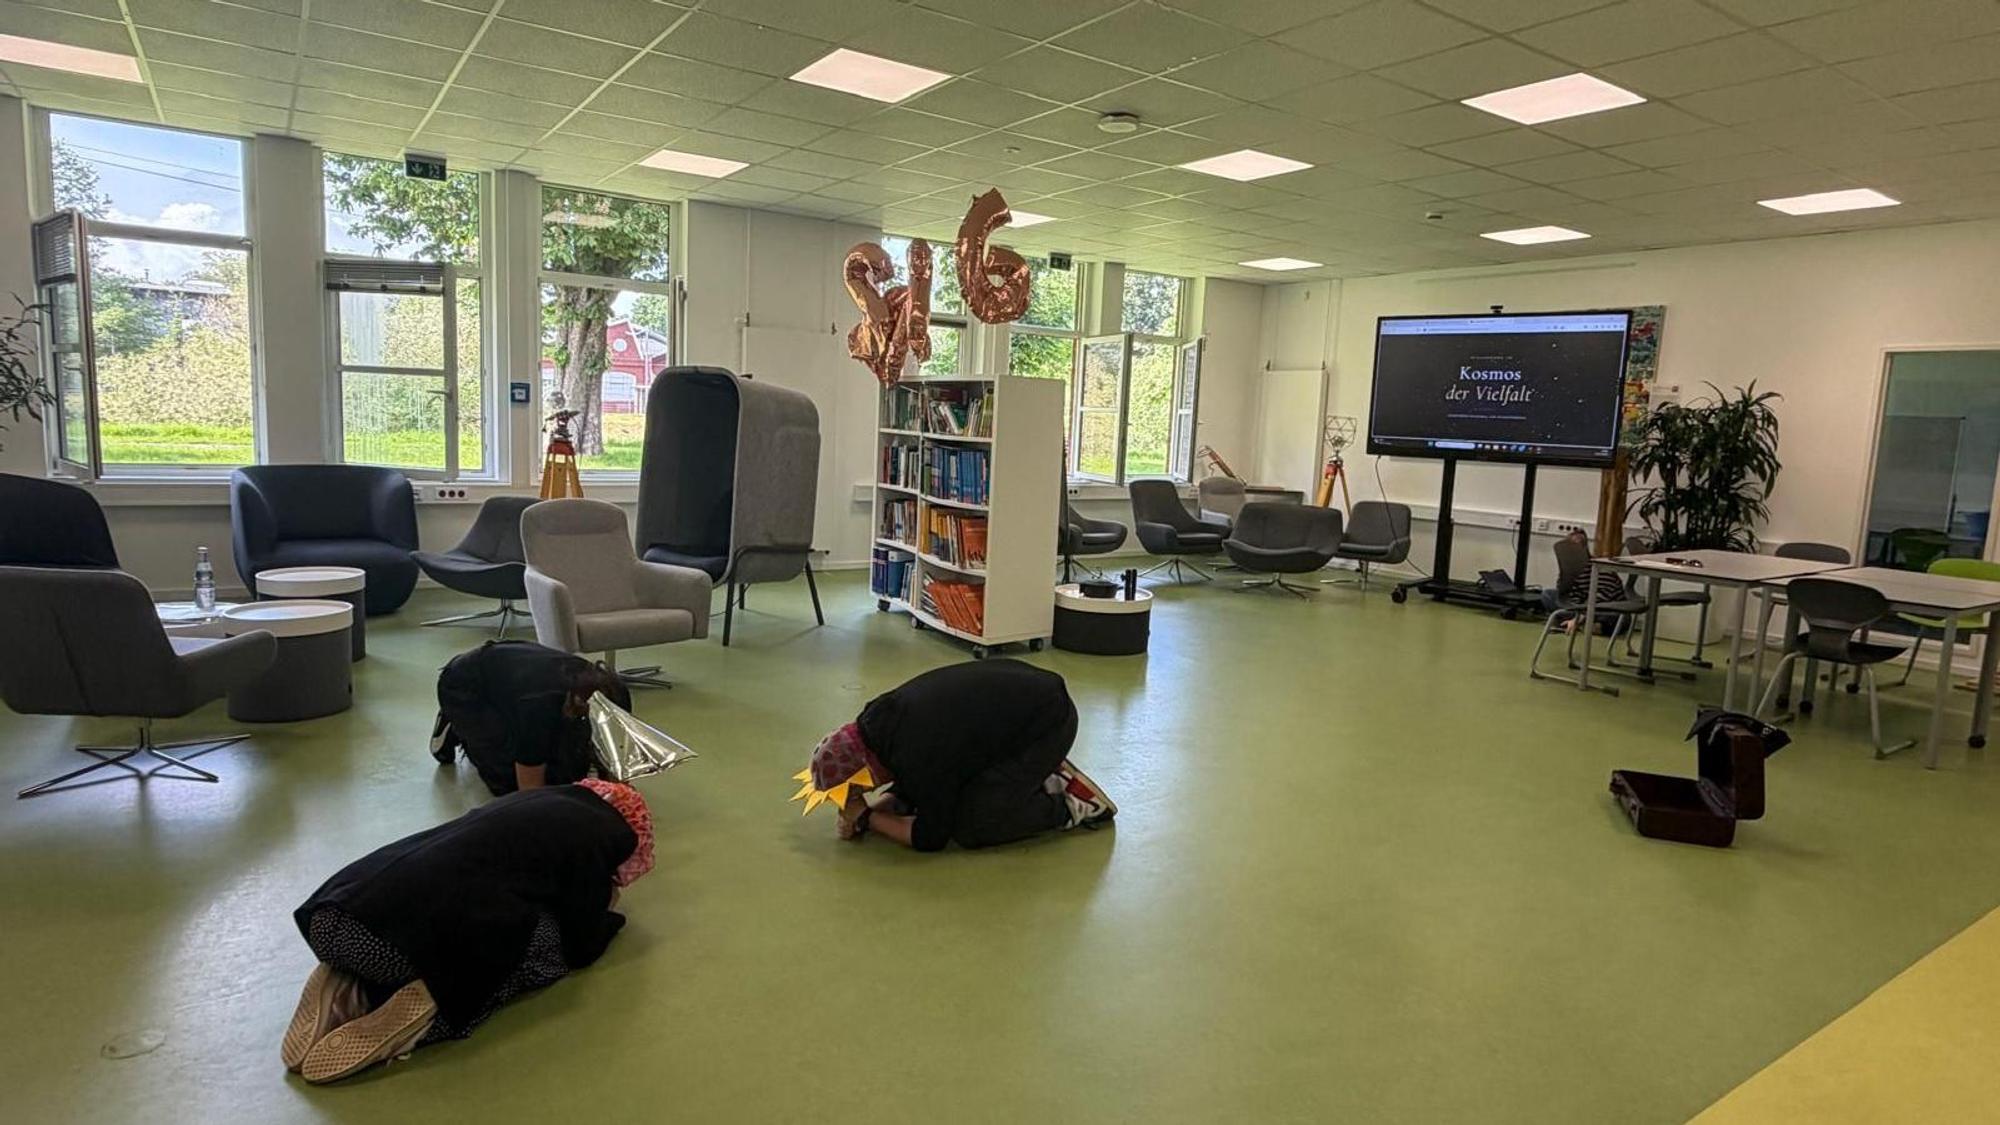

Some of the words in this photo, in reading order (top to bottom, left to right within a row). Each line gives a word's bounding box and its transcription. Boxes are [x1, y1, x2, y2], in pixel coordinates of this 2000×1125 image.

[956, 187, 1030, 324] 6
[1460, 366, 1521, 381] Kosmos
[1445, 384, 1470, 401] der
[1476, 385, 1532, 407] Vielfalt
